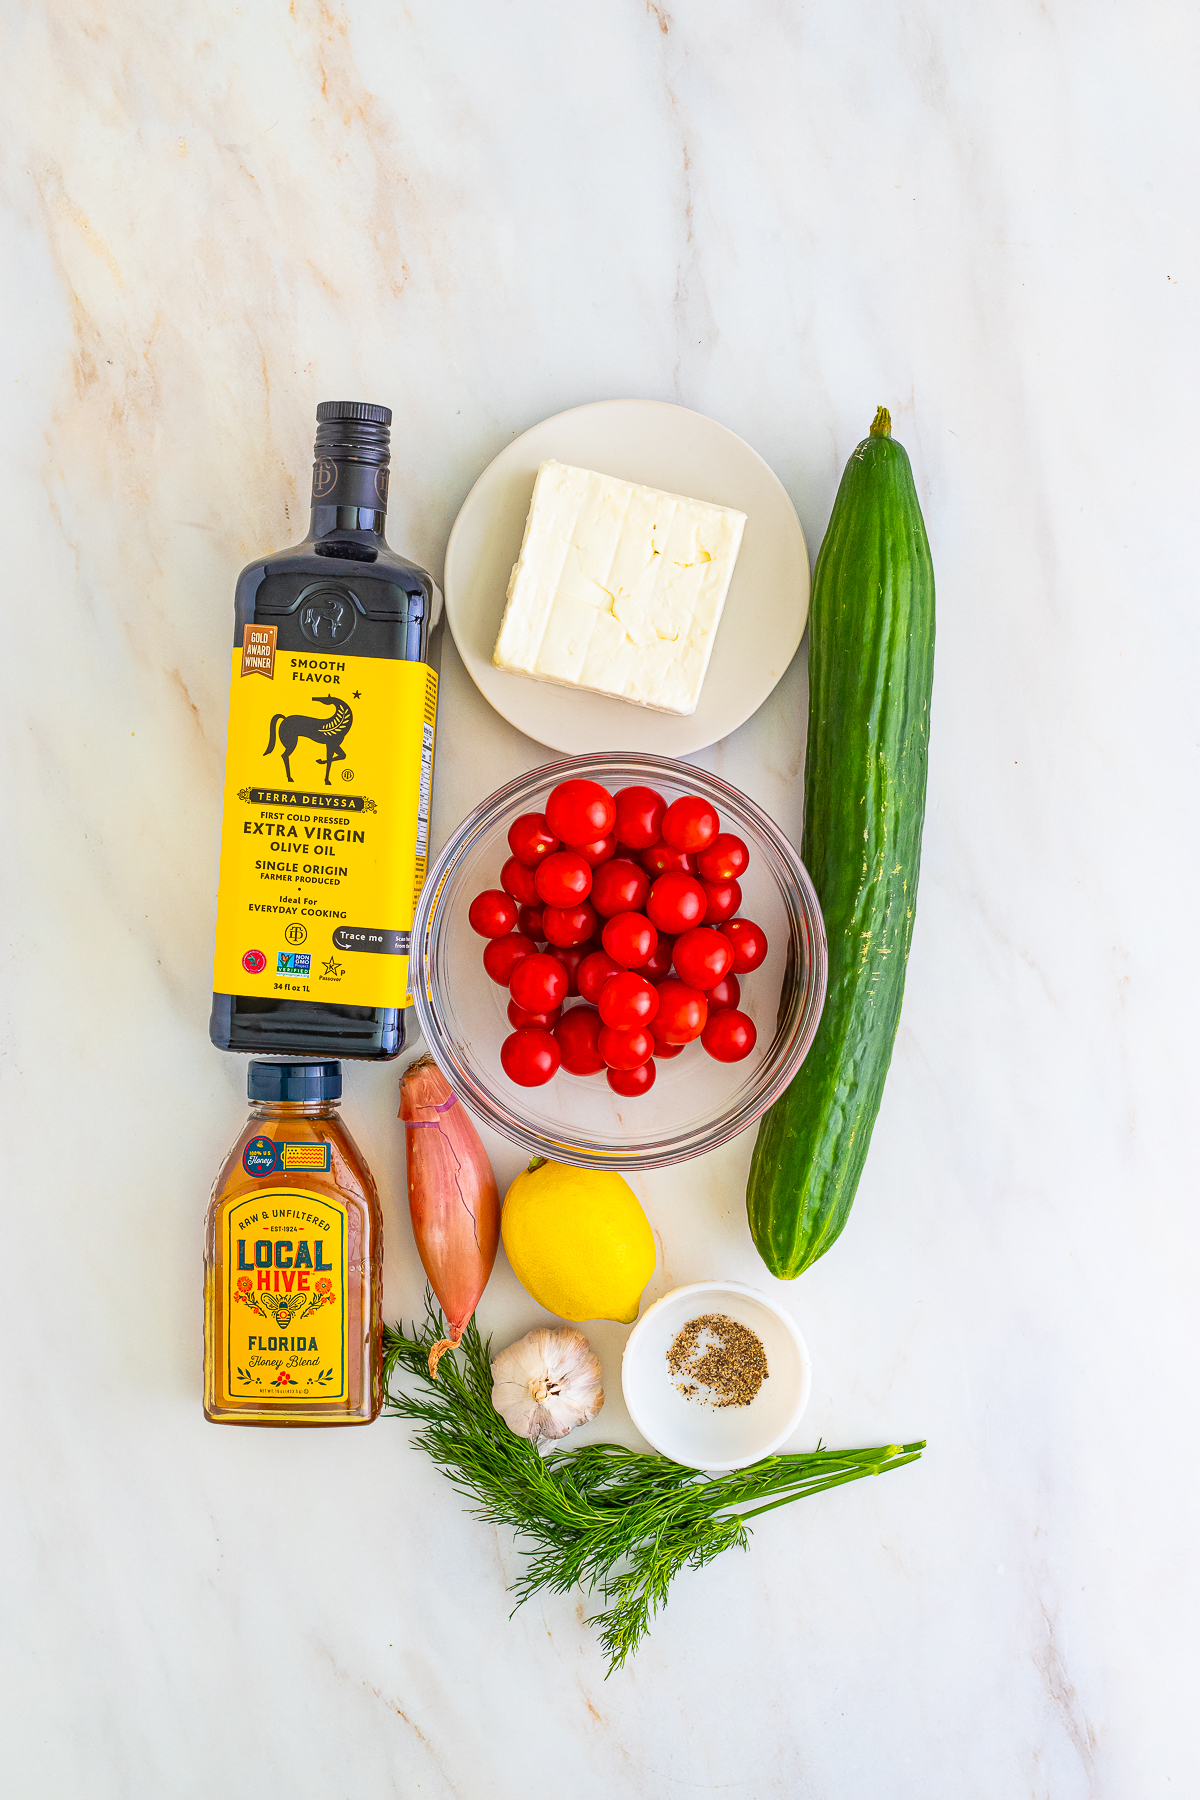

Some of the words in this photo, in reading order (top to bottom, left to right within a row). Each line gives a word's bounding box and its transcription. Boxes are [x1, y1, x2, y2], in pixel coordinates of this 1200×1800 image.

[251, 632, 269, 644] GOLD
[247, 644, 271, 657] AWARD
[245, 656, 271, 669] WINNER
[290, 658, 345, 672] SMOOTH
[292, 671, 341, 685] FLAVOR
[257, 791, 297, 804] TERRA
[302, 795, 356, 809] DELYSSA
[260, 811, 285, 820] FIRST
[286, 813, 311, 822] COLD
[313, 815, 350, 826] PRESSED
[243, 821, 298, 838] EXTRA
[303, 825, 365, 844] VIRGIN
[270, 841, 309, 854] OLIVE
[313, 845, 336, 857] OIL
[254, 859, 299, 873] SINGLE
[302, 864, 348, 877] ORIGIN
[260, 872, 293, 882] FARMER
[294, 875, 341, 886] PRODUCED
[279, 895, 301, 904] Ideal
[303, 897, 318, 906] For
[248, 903, 298, 915] EVERYDAY
[300, 907, 347, 919] COOKING
[340, 930, 366, 941] Trace
[368, 935, 384, 943] me
[318, 974, 342, 982] Passover
[273, 982, 283, 990] 34
[284, 983, 291, 991] fl
[247, 1155, 273, 1167] Honey
[238, 1213, 259, 1231] RAW
[261, 1211, 270, 1220] &
[271, 1209, 331, 1232] UNFILTERED
[236, 1239, 332, 1272] LOCAL
[256, 1270, 311, 1293] HIVE
[248, 1335, 318, 1352] FLORIDA
[248, 1355, 284, 1371] Honey
[285, 1354, 321, 1369] Blend
